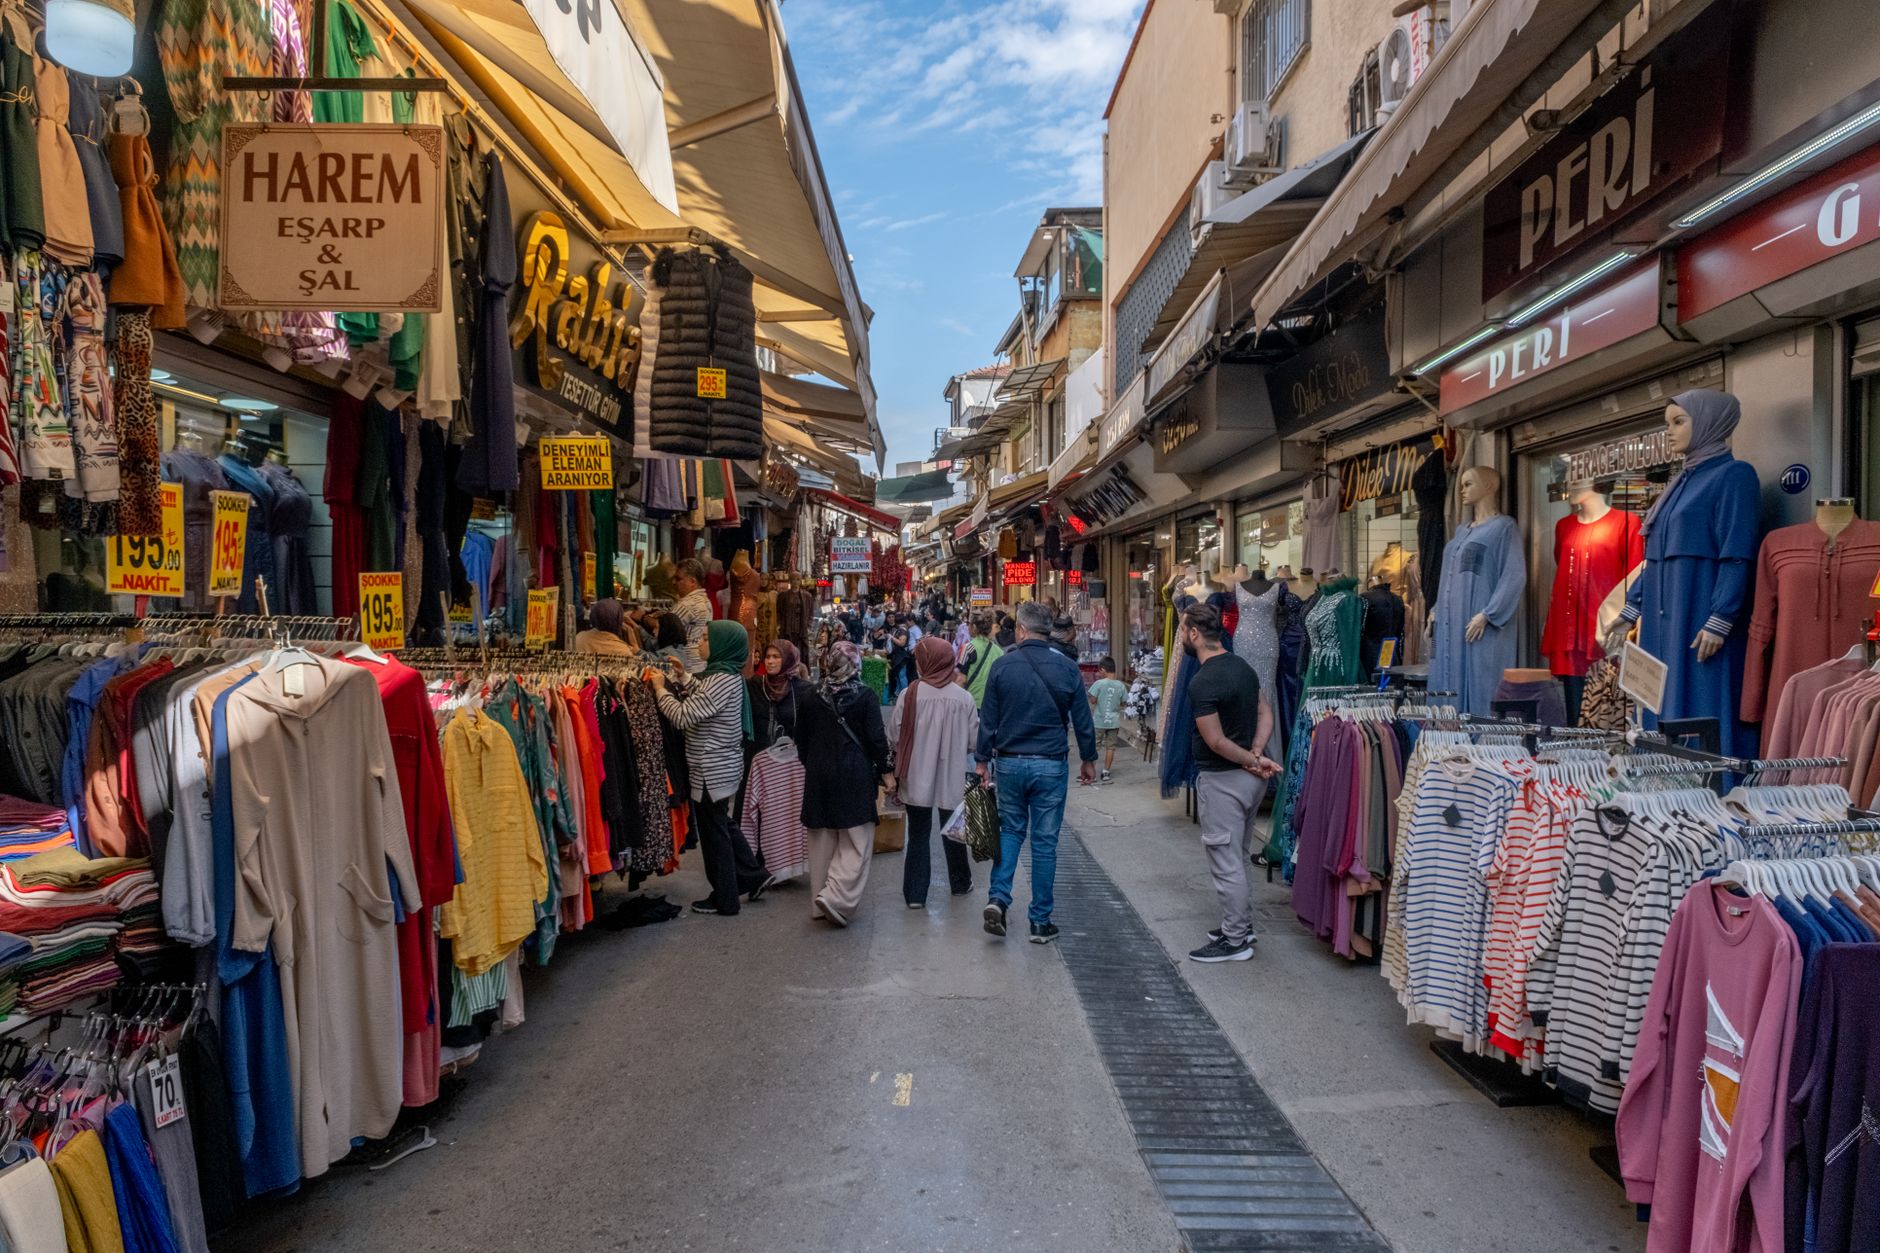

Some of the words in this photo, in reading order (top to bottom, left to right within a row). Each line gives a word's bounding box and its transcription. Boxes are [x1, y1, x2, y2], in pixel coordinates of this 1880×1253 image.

[242, 152, 422, 204] HAREM
[1519, 64, 1655, 270] PERİ
[277, 217, 386, 244] EŞARP
[1817, 183, 1880, 246] G
[317, 244, 343, 265] &
[298, 270, 360, 296] ŞAL
[510, 211, 641, 394] Rabia
[1489, 306, 1570, 389] PERİ
[559, 371, 601, 414] TESETTÜR
[700, 375, 718, 391] 295
[543, 442, 609, 456] DENEYİMLİ
[552, 457, 602, 471] ELEMAN
[1614, 430, 1686, 473] BULUNU
[546, 472, 610, 486] ARANIYOR
[1341, 448, 1385, 512] Dilek
[116, 535, 165, 570] 195
[215, 519, 239, 571] 195
[832, 562, 870, 570] HAZIRLANIR
[1007, 569, 1032, 577] PİDE
[362, 593, 393, 634] 195
[155, 1073, 175, 1112] 70
